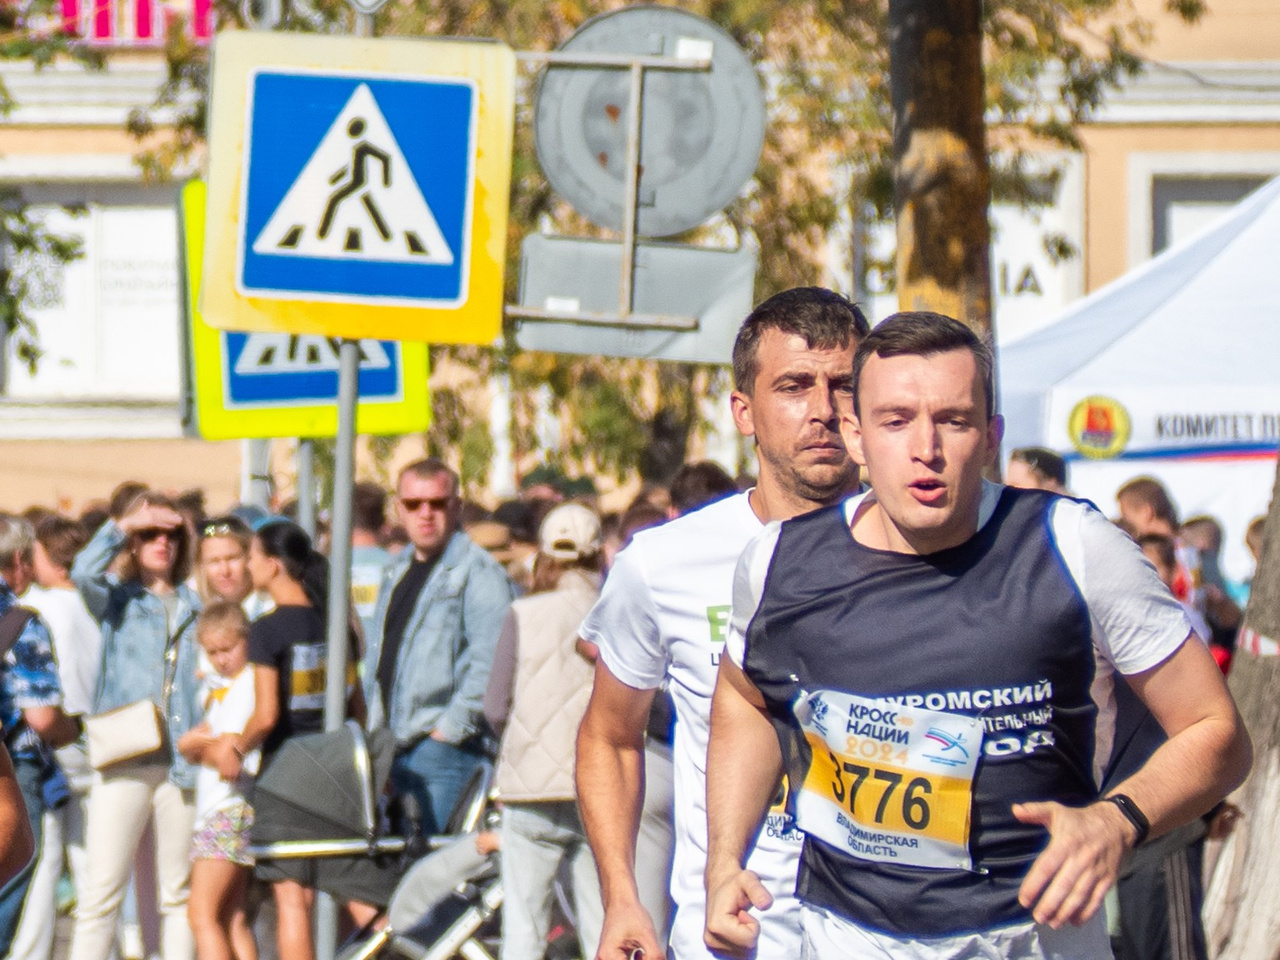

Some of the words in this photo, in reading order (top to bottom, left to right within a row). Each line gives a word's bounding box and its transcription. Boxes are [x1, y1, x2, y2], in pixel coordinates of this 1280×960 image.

[1156, 413, 1252, 439] КОМИТЕТ
[848, 703, 898, 726] КРОСС
[846, 719, 910, 745] НАЦИИ
[845, 736, 908, 764] 2024
[828, 750, 933, 831] 3776
[836, 812, 919, 849] ВЛАДИМИРСКАЯ
[847, 835, 898, 858] ОБЛАСТЬ
